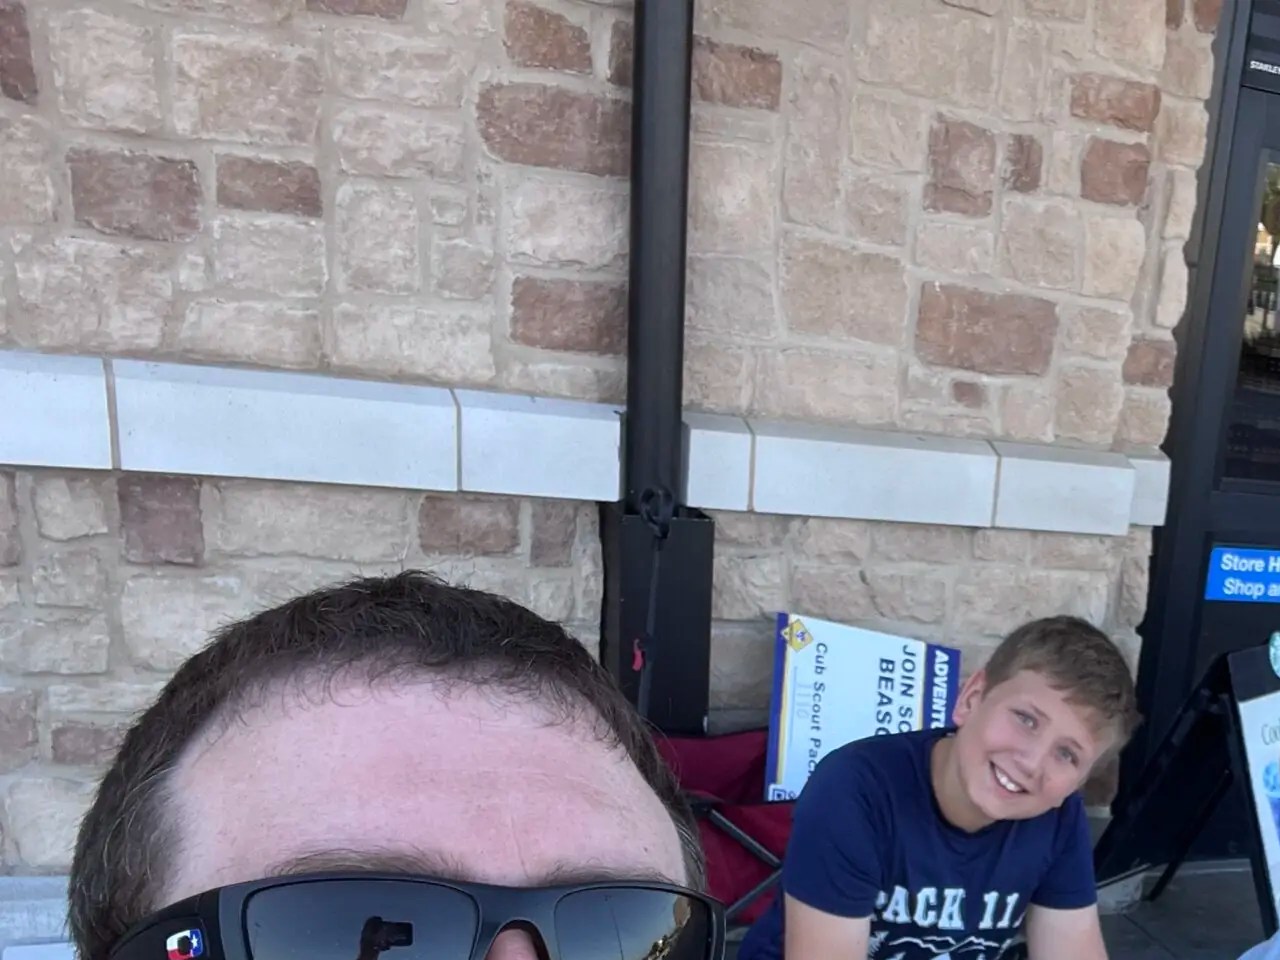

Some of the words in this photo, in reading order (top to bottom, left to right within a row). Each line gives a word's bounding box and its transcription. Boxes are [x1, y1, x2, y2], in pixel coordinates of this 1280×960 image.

[1221, 553, 1265, 572] Store
[1223, 577, 1265, 599] Shop
[816, 642, 828, 675] Cub
[900, 645, 916, 698] JOIN
[810, 681, 826, 731] Scout
